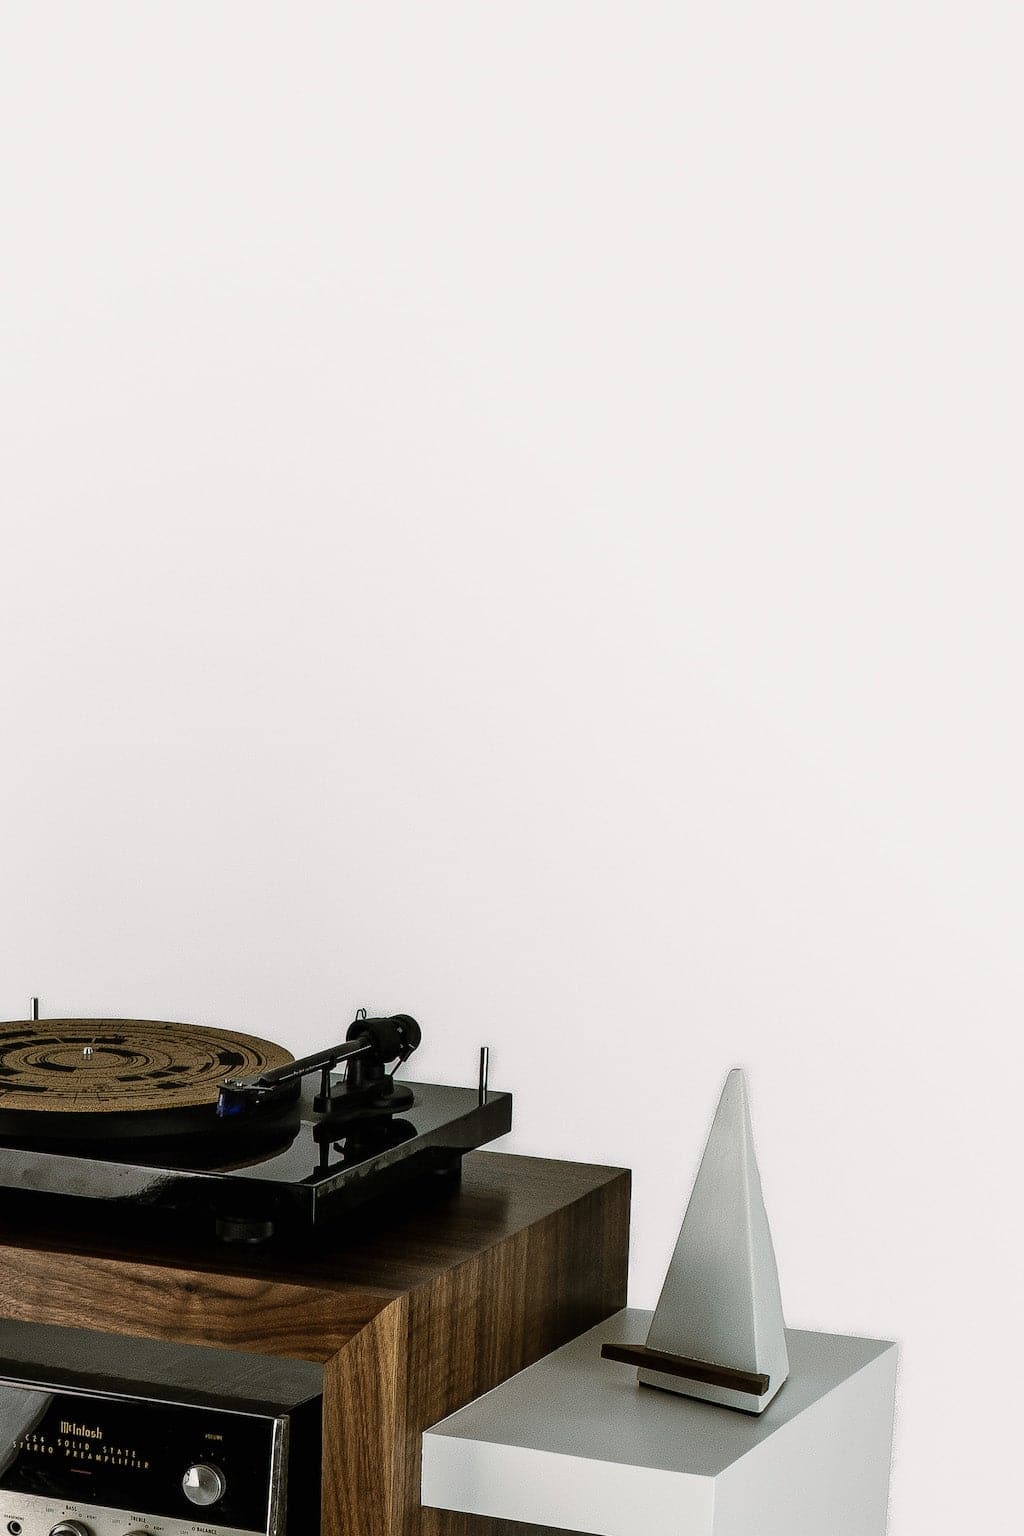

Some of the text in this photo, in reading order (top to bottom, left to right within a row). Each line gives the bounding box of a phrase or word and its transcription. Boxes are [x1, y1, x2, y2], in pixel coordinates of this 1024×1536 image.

[60, 1420, 104, 1440] McIntosh
[12, 1440, 150, 1469] STEREO PREAMPLIFIER
[57, 1438, 91, 1451] SOLID
[102, 1445, 137, 1458] STATE
